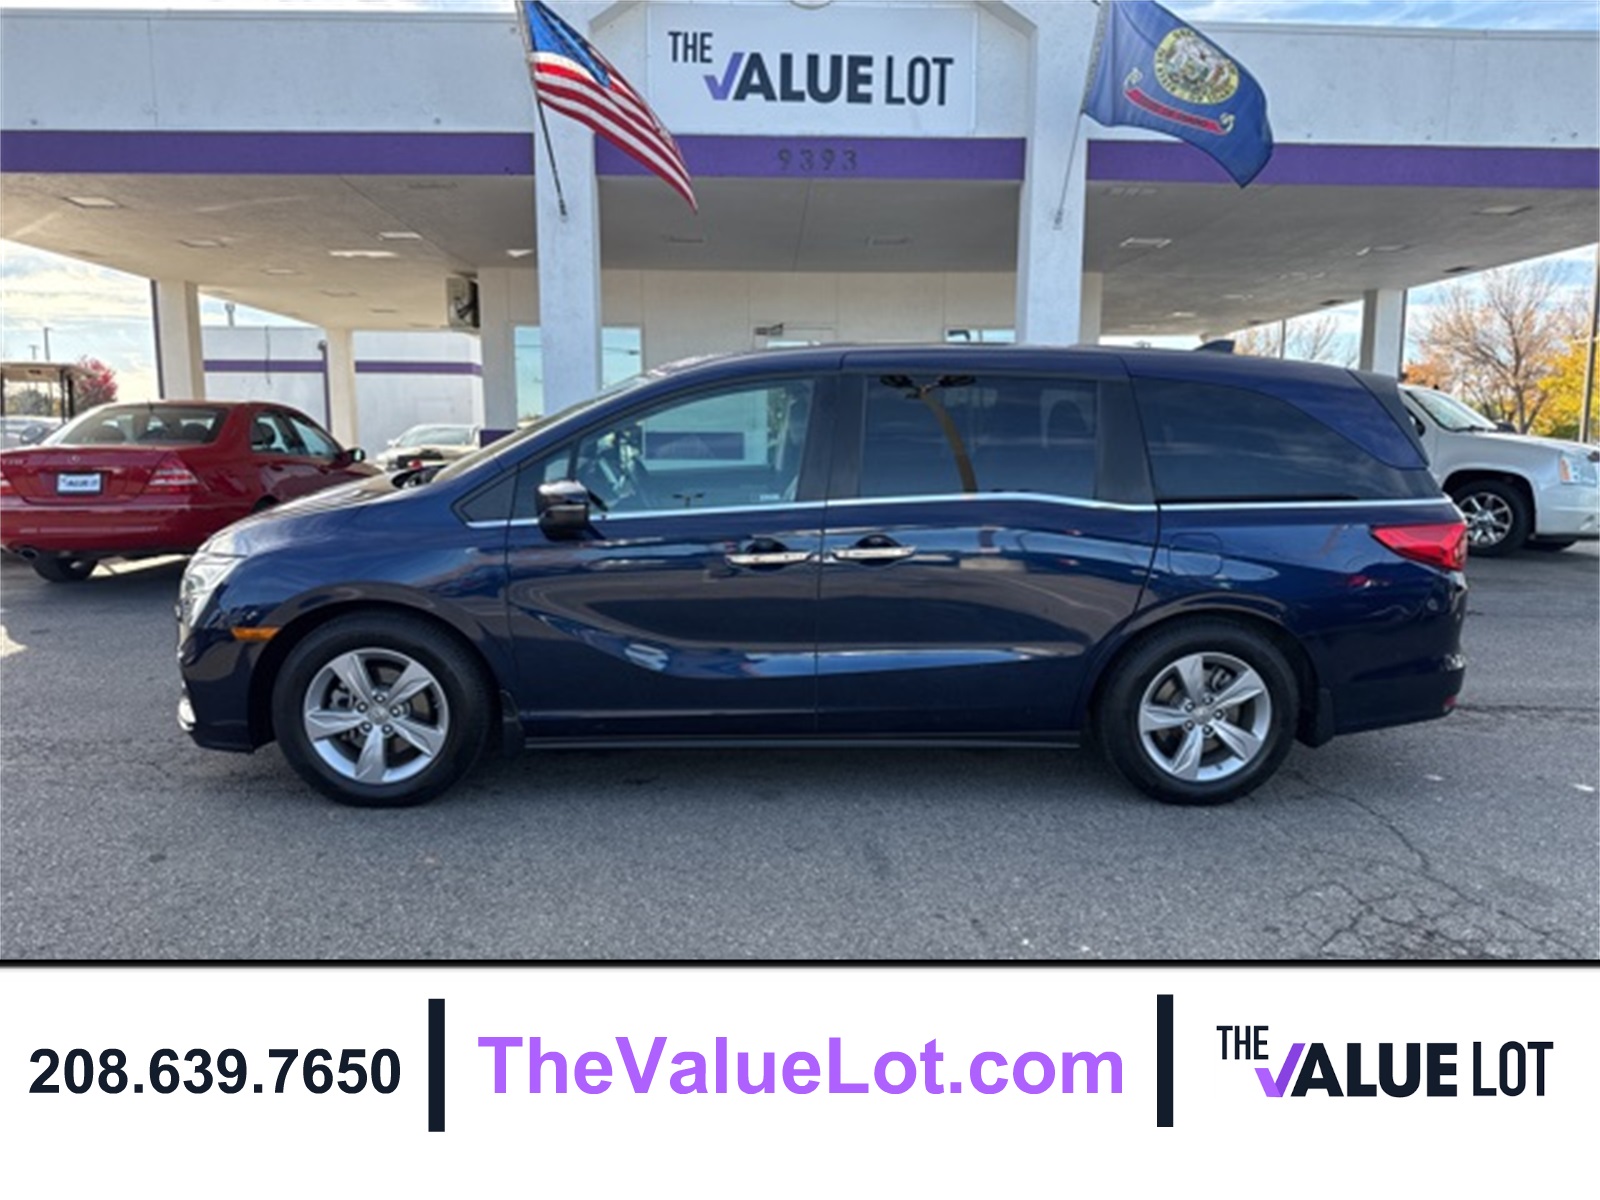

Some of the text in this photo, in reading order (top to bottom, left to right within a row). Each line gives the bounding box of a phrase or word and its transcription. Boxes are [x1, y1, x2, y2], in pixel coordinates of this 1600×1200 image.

[668, 31, 713, 63] THE
[704, 52, 954, 106] VALUE LOT
[777, 148, 859, 171] 9393
